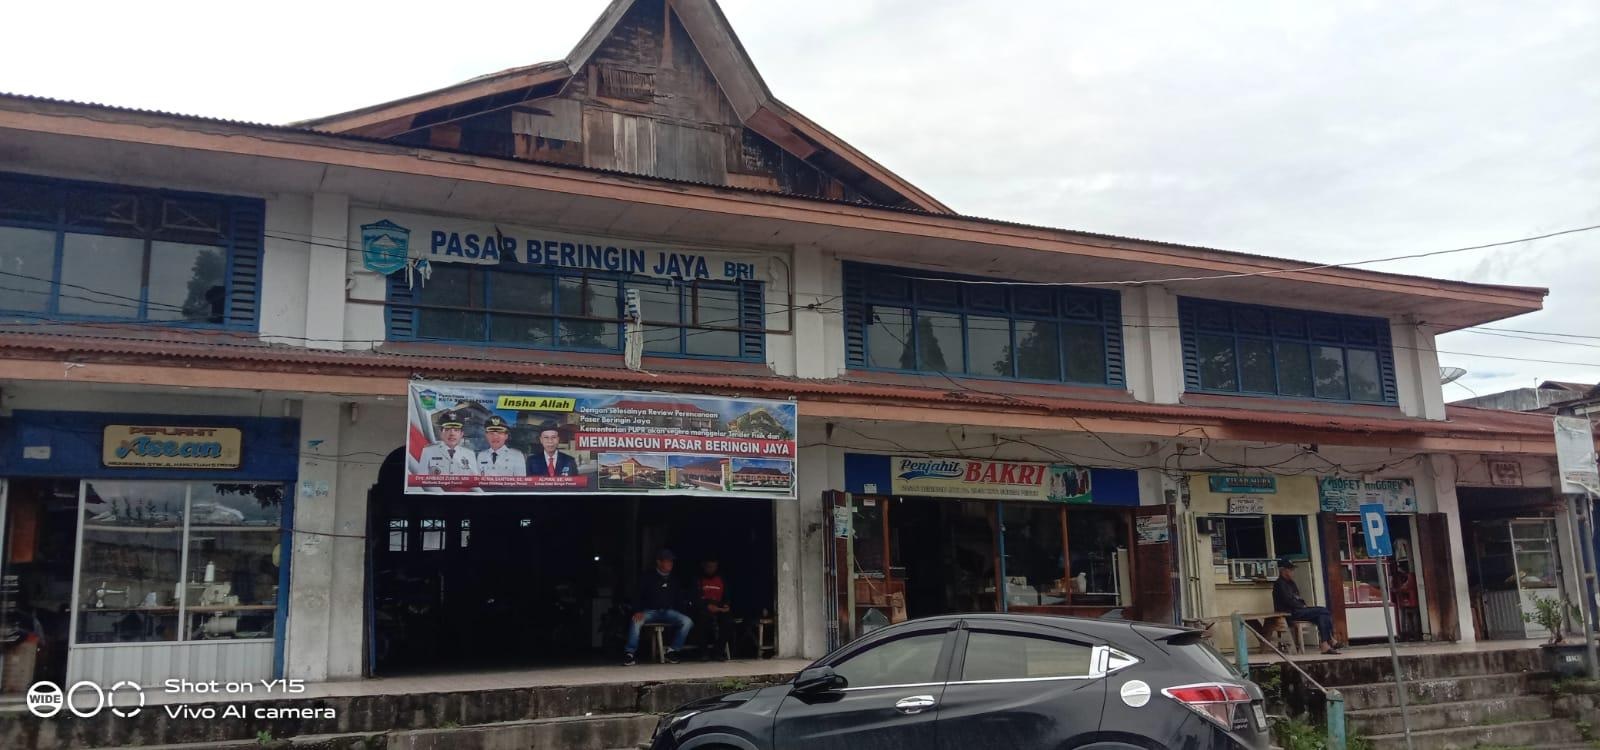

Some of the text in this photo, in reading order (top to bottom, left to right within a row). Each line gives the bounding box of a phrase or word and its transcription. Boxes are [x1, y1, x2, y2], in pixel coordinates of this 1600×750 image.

[431, 230, 754, 280] PASAR BERINGIN JAYA BRI
[503, 397, 569, 409] Insha Allah
[580, 406, 718, 418] Dengan selesainya Review Perencanaan
[601, 416, 630, 424] Beringin
[628, 426, 646, 434] PUPR
[690, 429, 727, 438] menggelar
[728, 430, 750, 438] Tender
[115, 436, 222, 458] Asean
[579, 436, 789, 454] MEMBANGUN PASAR BERINGIN JAYA
[900, 458, 1046, 485] Penjahit BAKRI
[1366, 512, 1384, 550] P
